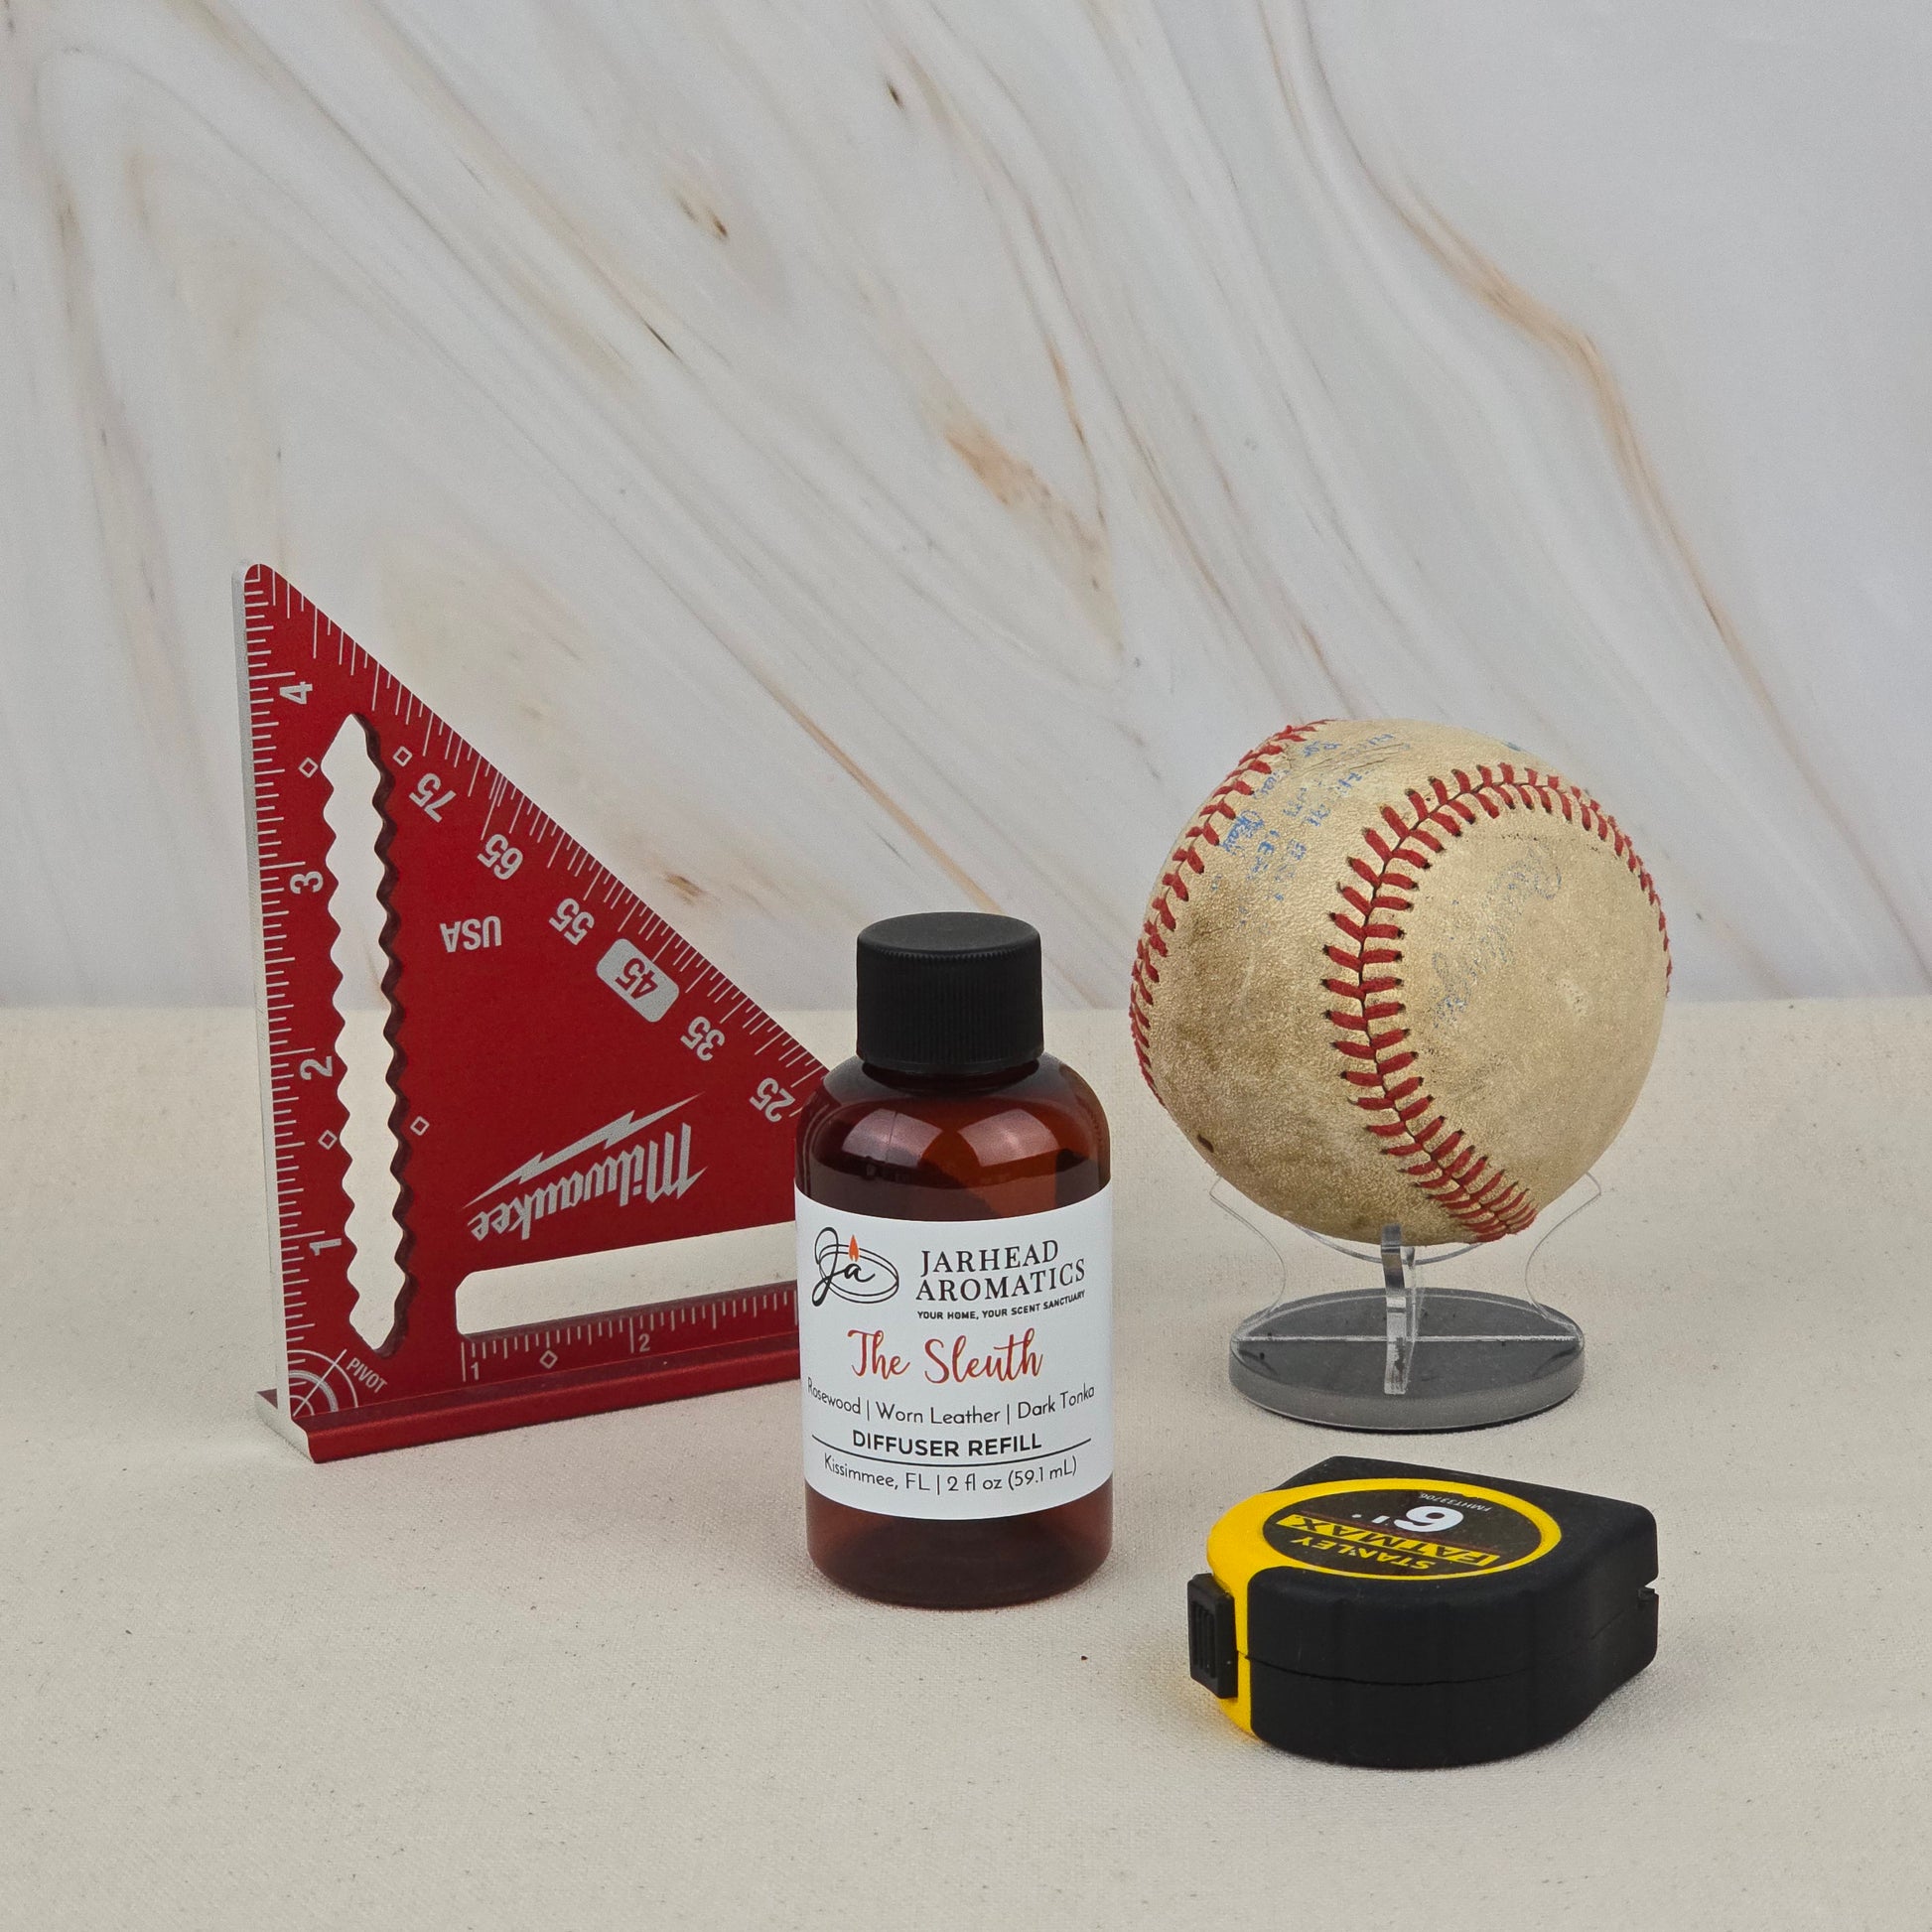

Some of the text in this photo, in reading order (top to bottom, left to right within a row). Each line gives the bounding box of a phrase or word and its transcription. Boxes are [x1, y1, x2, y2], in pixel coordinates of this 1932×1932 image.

[279, 681, 314, 705] 4
[408, 772, 457, 823] 75
[477, 834, 523, 881] 65
[289, 871, 324, 896] 3
[440, 915, 502, 953] USA
[548, 897, 595, 945] 55
[615, 957, 660, 1001] 45
[680, 1016, 725, 1061] 35
[299, 1055, 334, 1081] 2
[749, 1077, 795, 1123] 25
[467, 1122, 708, 1241] Milwaukee
[309, 1237, 343, 1256] 1
[920, 1239, 1059, 1278] JARHEAD
[915, 1258, 1086, 1302] AROMATICS
[917, 1290, 1086, 1320] YOUR HOME, YOUR SCENT SANCTUARY
[638, 1333, 650, 1352] 2
[847, 1327, 1043, 1384] The Sleuth
[346, 1357, 388, 1393] PIVOT
[470, 1362, 481, 1381] 1
[807, 1376, 862, 1415] Rosewood
[875, 1402, 923, 1424] Worn
[930, 1406, 1001, 1425] Leather
[1018, 1395, 1056, 1419] Dark
[1059, 1382, 1095, 1410] Tonka
[852, 1429, 1042, 1457] DIFFUSER REFILL
[823, 1452, 898, 1489] Kissimmee,
[904, 1472, 931, 1491] FL
[947, 1475, 960, 1491] 2
[964, 1472, 976, 1492] fl
[982, 1477, 1003, 1490] oz
[1008, 1466, 1044, 1491] (59.1
[1048, 1455, 1078, 1481] mL)
[1292, 1536, 1437, 1571] STANLEY
[1293, 1514, 1495, 1566] FATMAX
